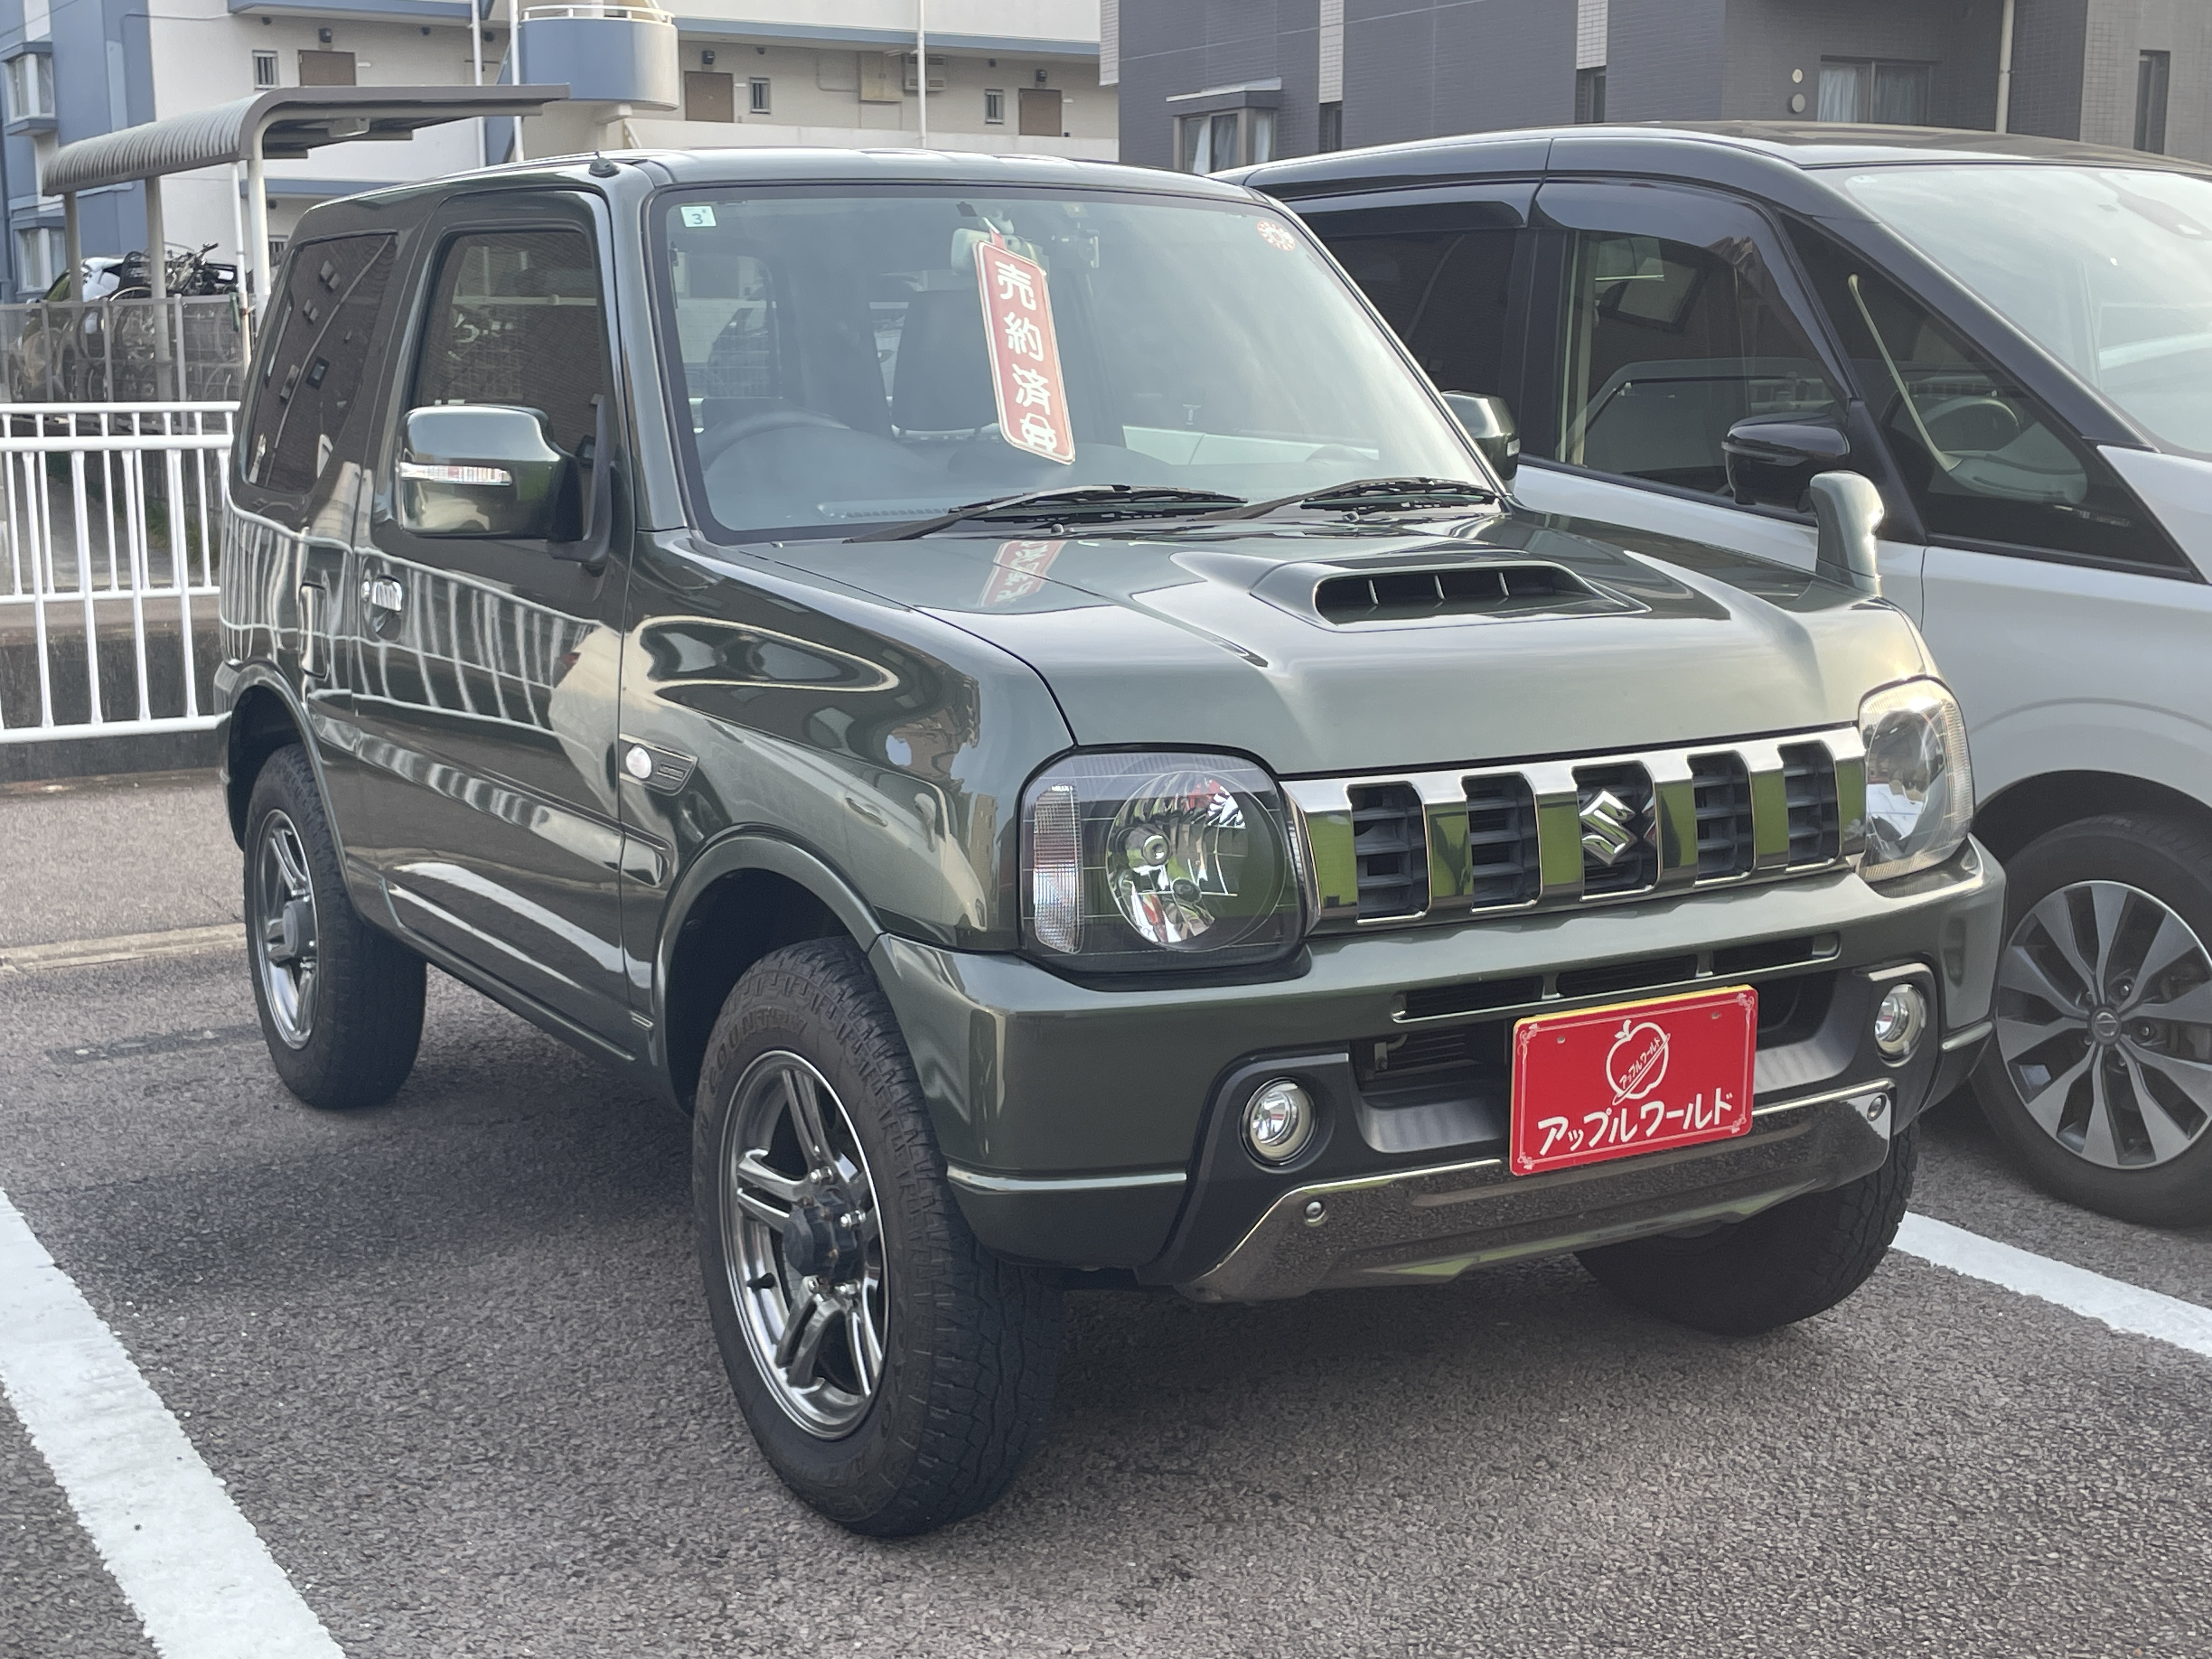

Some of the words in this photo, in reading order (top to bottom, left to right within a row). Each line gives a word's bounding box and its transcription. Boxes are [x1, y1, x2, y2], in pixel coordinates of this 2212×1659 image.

[691, 213, 703, 224] 3
[995, 259, 1052, 416] 売約済
[1537, 1087, 1733, 1156] アップルワールド
